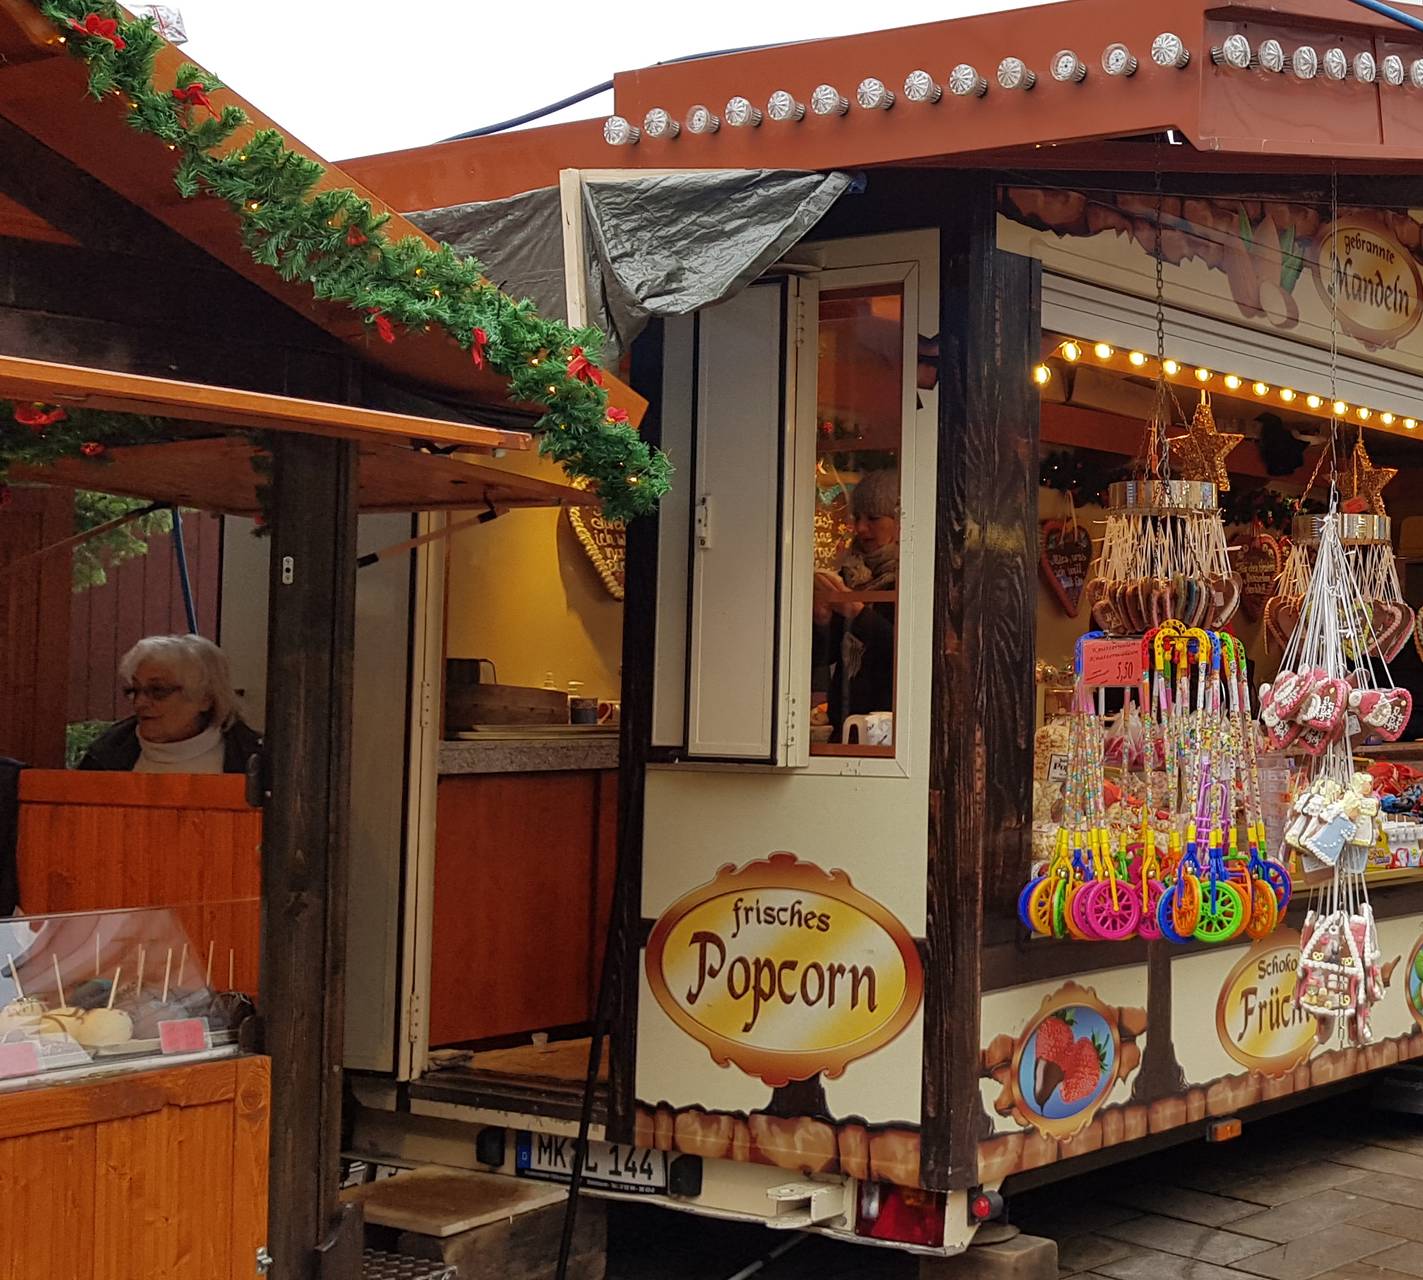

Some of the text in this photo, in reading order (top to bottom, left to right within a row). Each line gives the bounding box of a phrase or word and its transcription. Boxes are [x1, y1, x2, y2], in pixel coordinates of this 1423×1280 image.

[1343, 232, 1396, 265] gebrannte
[1328, 250, 1410, 317] Mandeln
[1116, 661, 1134, 682] 5,50
[731, 897, 832, 939] frisches
[685, 930, 879, 1033] Popcorn
[537, 1133, 567, 1169] MK
[608, 1144, 654, 1181] 144
